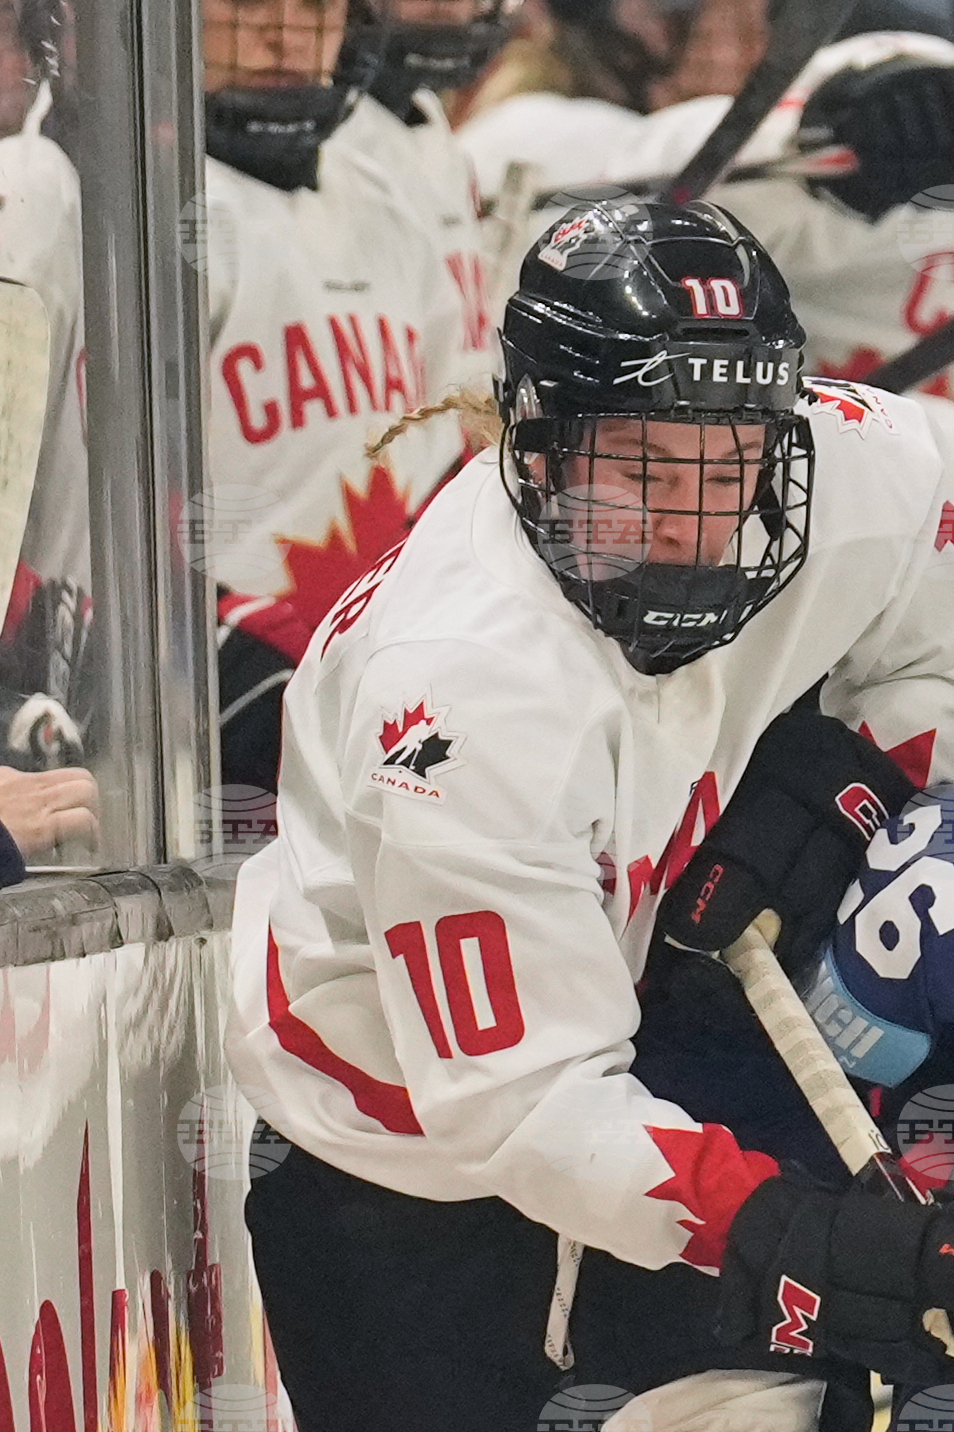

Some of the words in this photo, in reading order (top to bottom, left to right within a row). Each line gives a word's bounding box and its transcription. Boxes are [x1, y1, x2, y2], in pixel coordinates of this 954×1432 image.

[681, 275, 744, 319] 10
[688, 358, 790, 386] TELUS
[371, 771, 441, 799] CANADA
[384, 910, 525, 1059] 10
